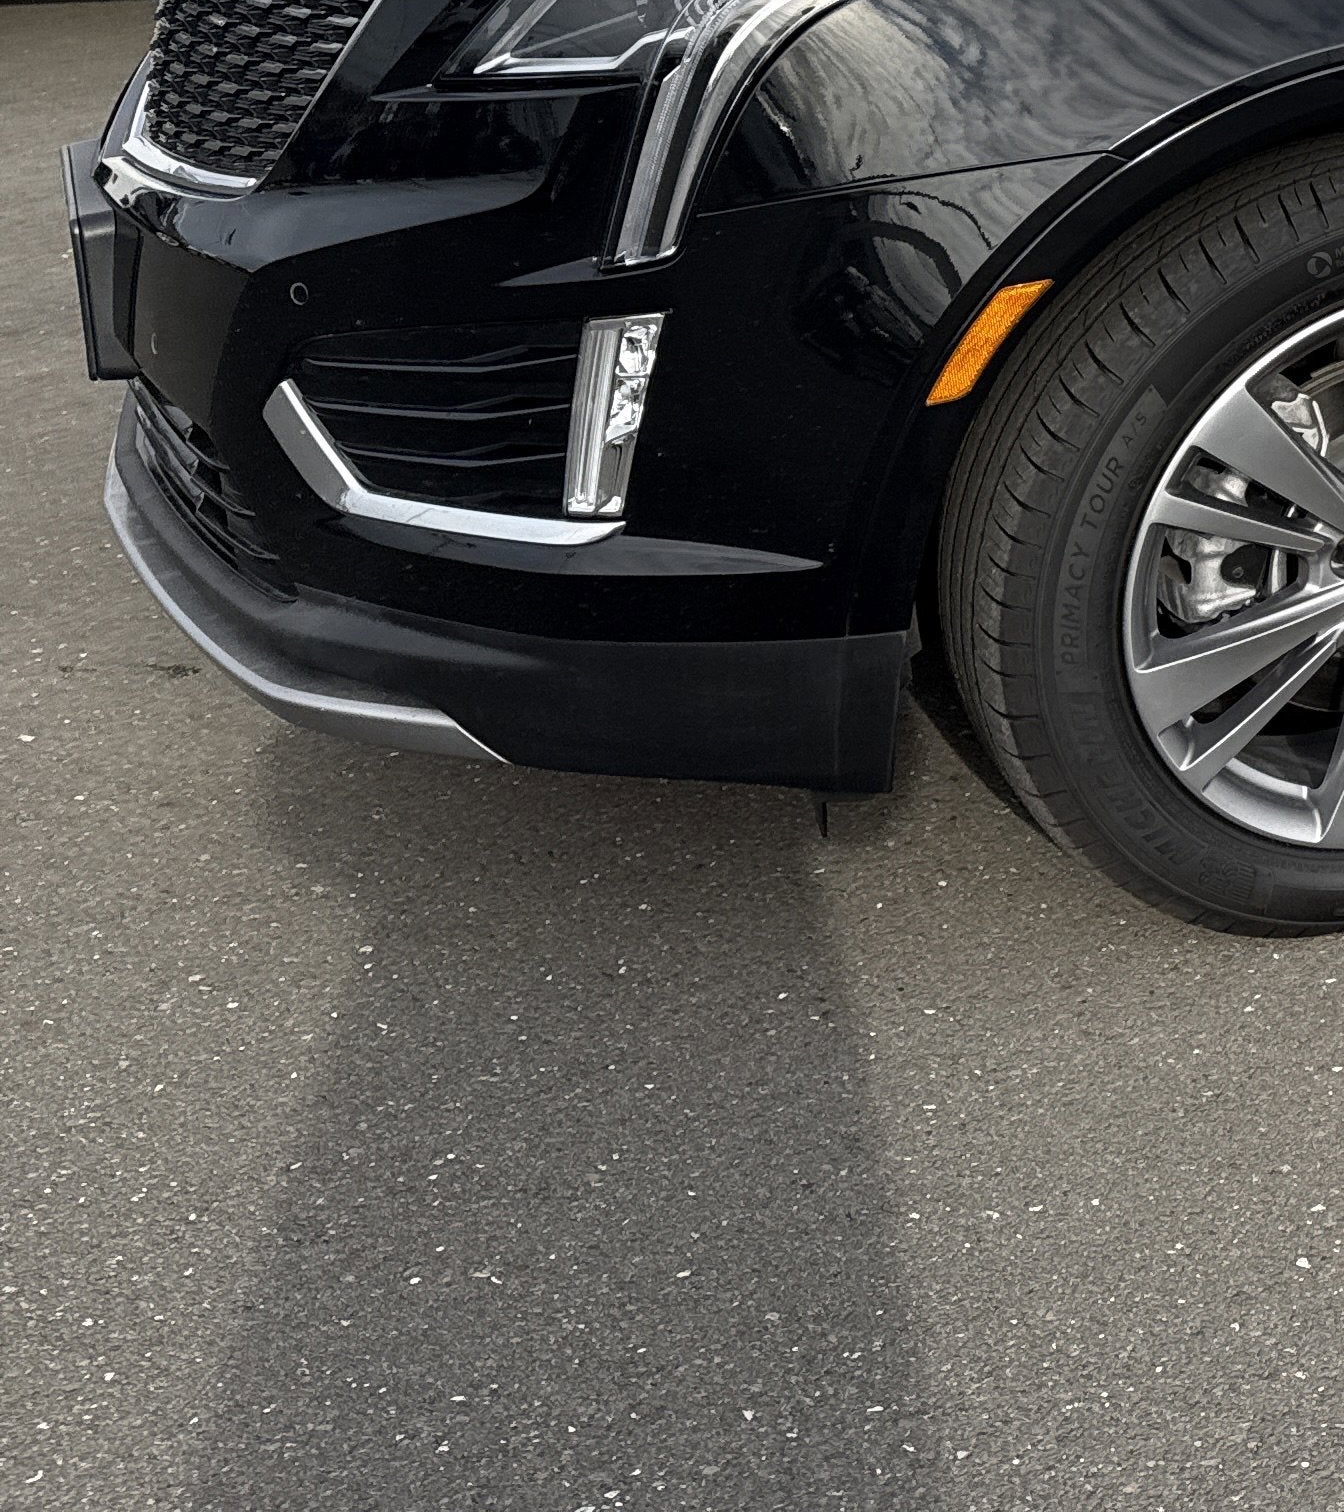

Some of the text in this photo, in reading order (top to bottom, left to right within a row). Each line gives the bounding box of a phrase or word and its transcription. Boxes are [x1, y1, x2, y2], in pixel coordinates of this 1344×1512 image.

[1061, 412, 1147, 665] PRIMACY TOUR A/S
